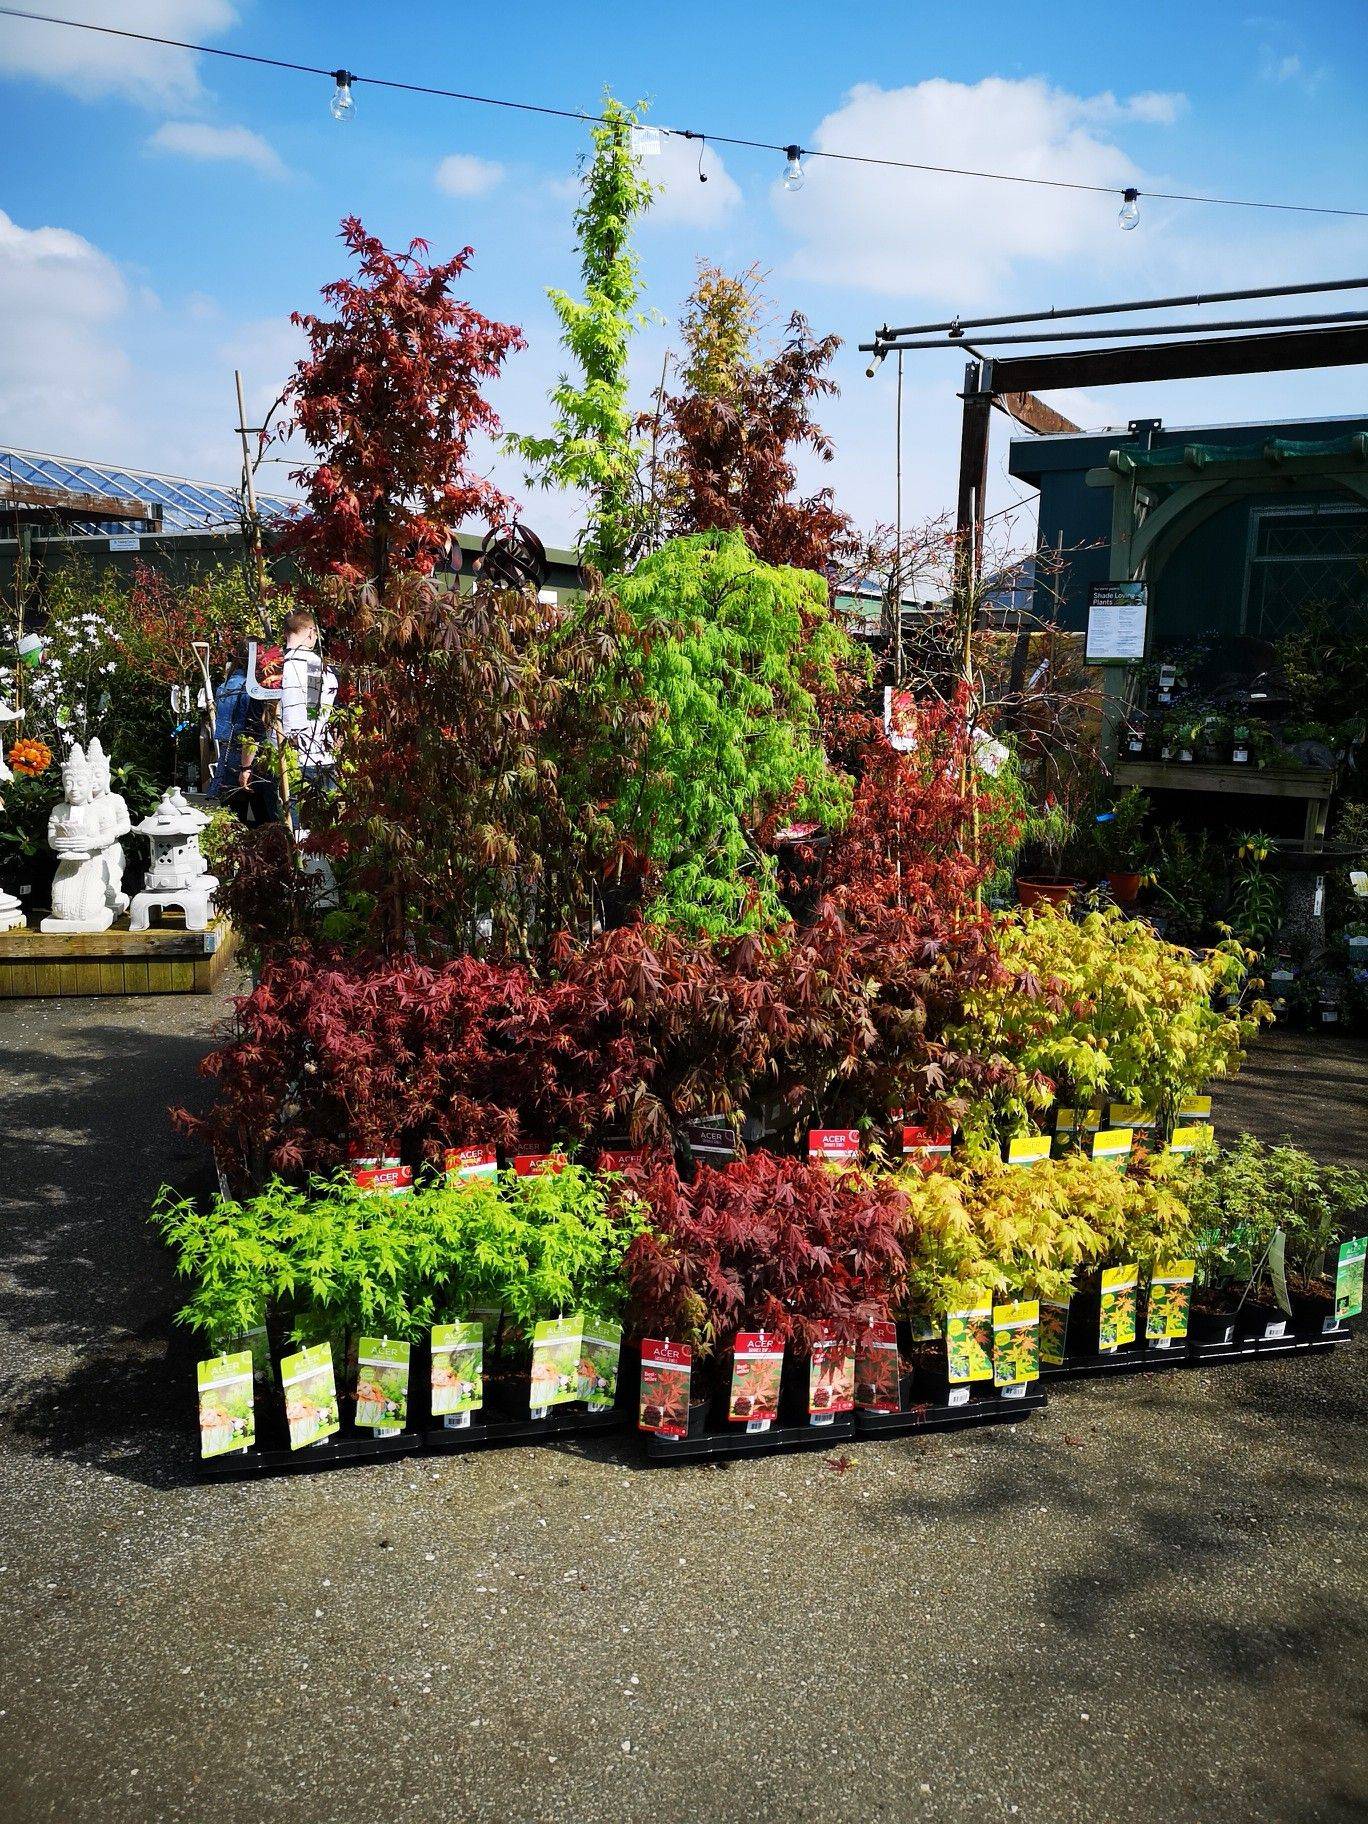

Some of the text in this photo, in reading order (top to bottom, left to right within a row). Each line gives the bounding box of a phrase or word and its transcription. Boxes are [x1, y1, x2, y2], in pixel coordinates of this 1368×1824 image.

[1114, 592, 1136, 600] Loving
[700, 1131, 722, 1141] ACER
[822, 1135, 846, 1143] ACER
[459, 1149, 483, 1160] ACER
[618, 1155, 642, 1163] ACER
[373, 1172, 399, 1182] ACER
[585, 1324, 610, 1336] ACER
[747, 1340, 774, 1348] ACER
[370, 1346, 398, 1356] ACER
[653, 1348, 680, 1359] ACER
